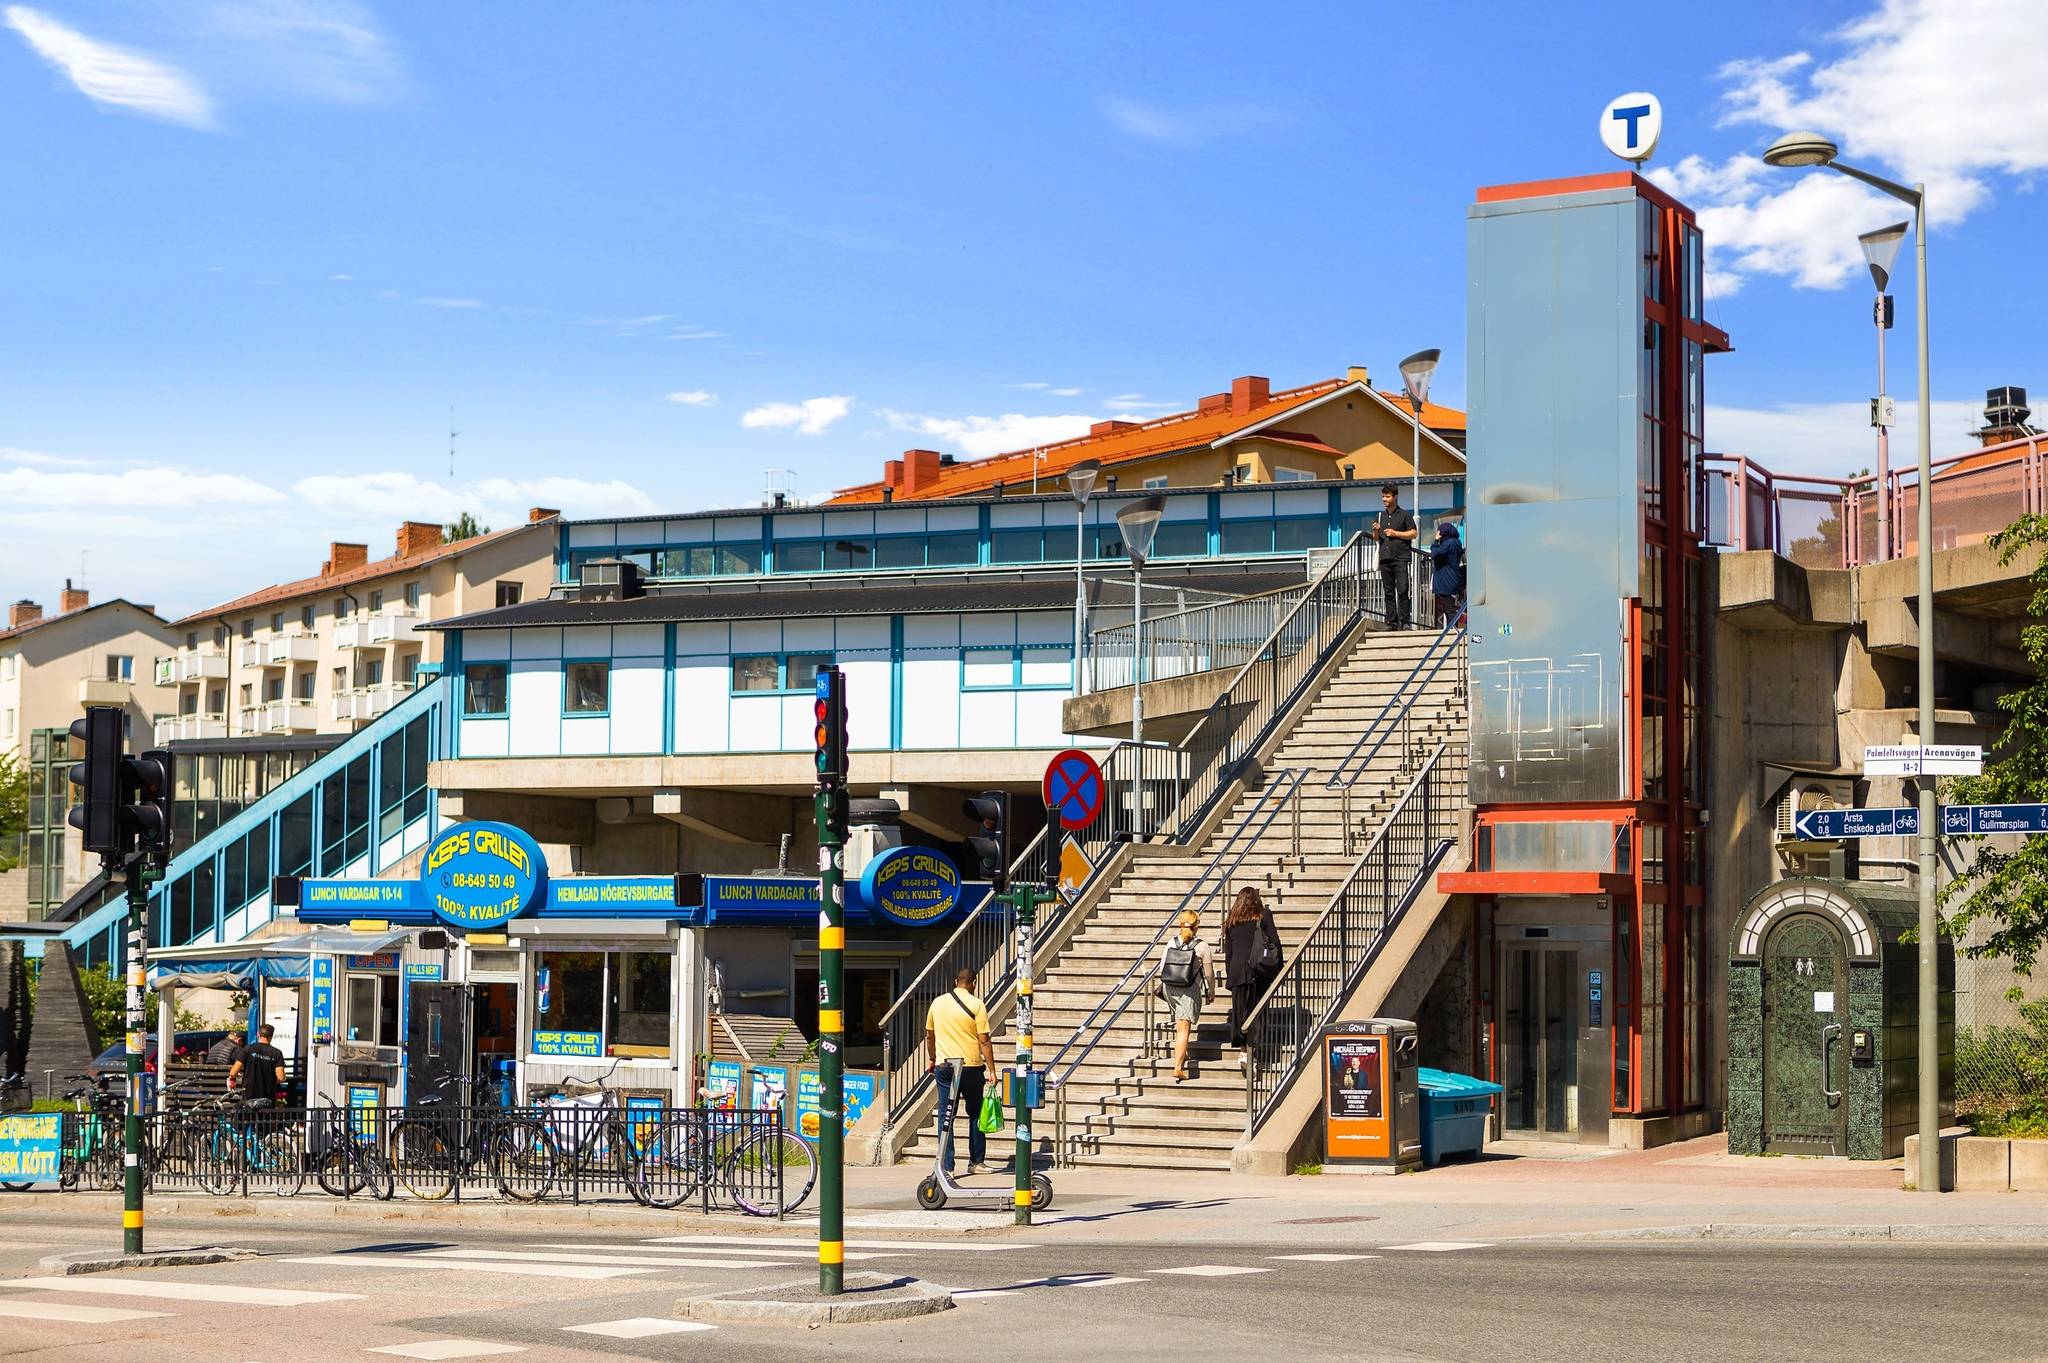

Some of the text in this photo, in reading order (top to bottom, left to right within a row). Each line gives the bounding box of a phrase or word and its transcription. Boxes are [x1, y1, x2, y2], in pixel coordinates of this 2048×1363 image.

[1612, 104, 1651, 149] T
[1866, 747, 1919, 759] Palmfeltsvägen
[1924, 747, 1976, 759] Arenavägen
[1903, 763, 1919, 772] 14-2
[1817, 811, 1863, 825] 2,0 Årsta
[1979, 808, 2002, 818] Farsta
[1817, 822, 1893, 836] 0,8 Enskede gård
[1979, 819, 2029, 830] Gullmarsplan
[428, 830, 471, 878] KEPS
[877, 855, 910, 888] KEPS
[453, 872, 516, 889] 08-649 50 49
[310, 886, 402, 901] LUNCH VARDAGAR 10-14
[557, 883, 673, 902] HEMLAGAD HÖGREVSBURGARE
[719, 885, 752, 900] LUNCH
[755, 886, 805, 901] VARDAGAR
[436, 894, 466, 919] 100%
[538, 1043, 560, 1054] 100%
